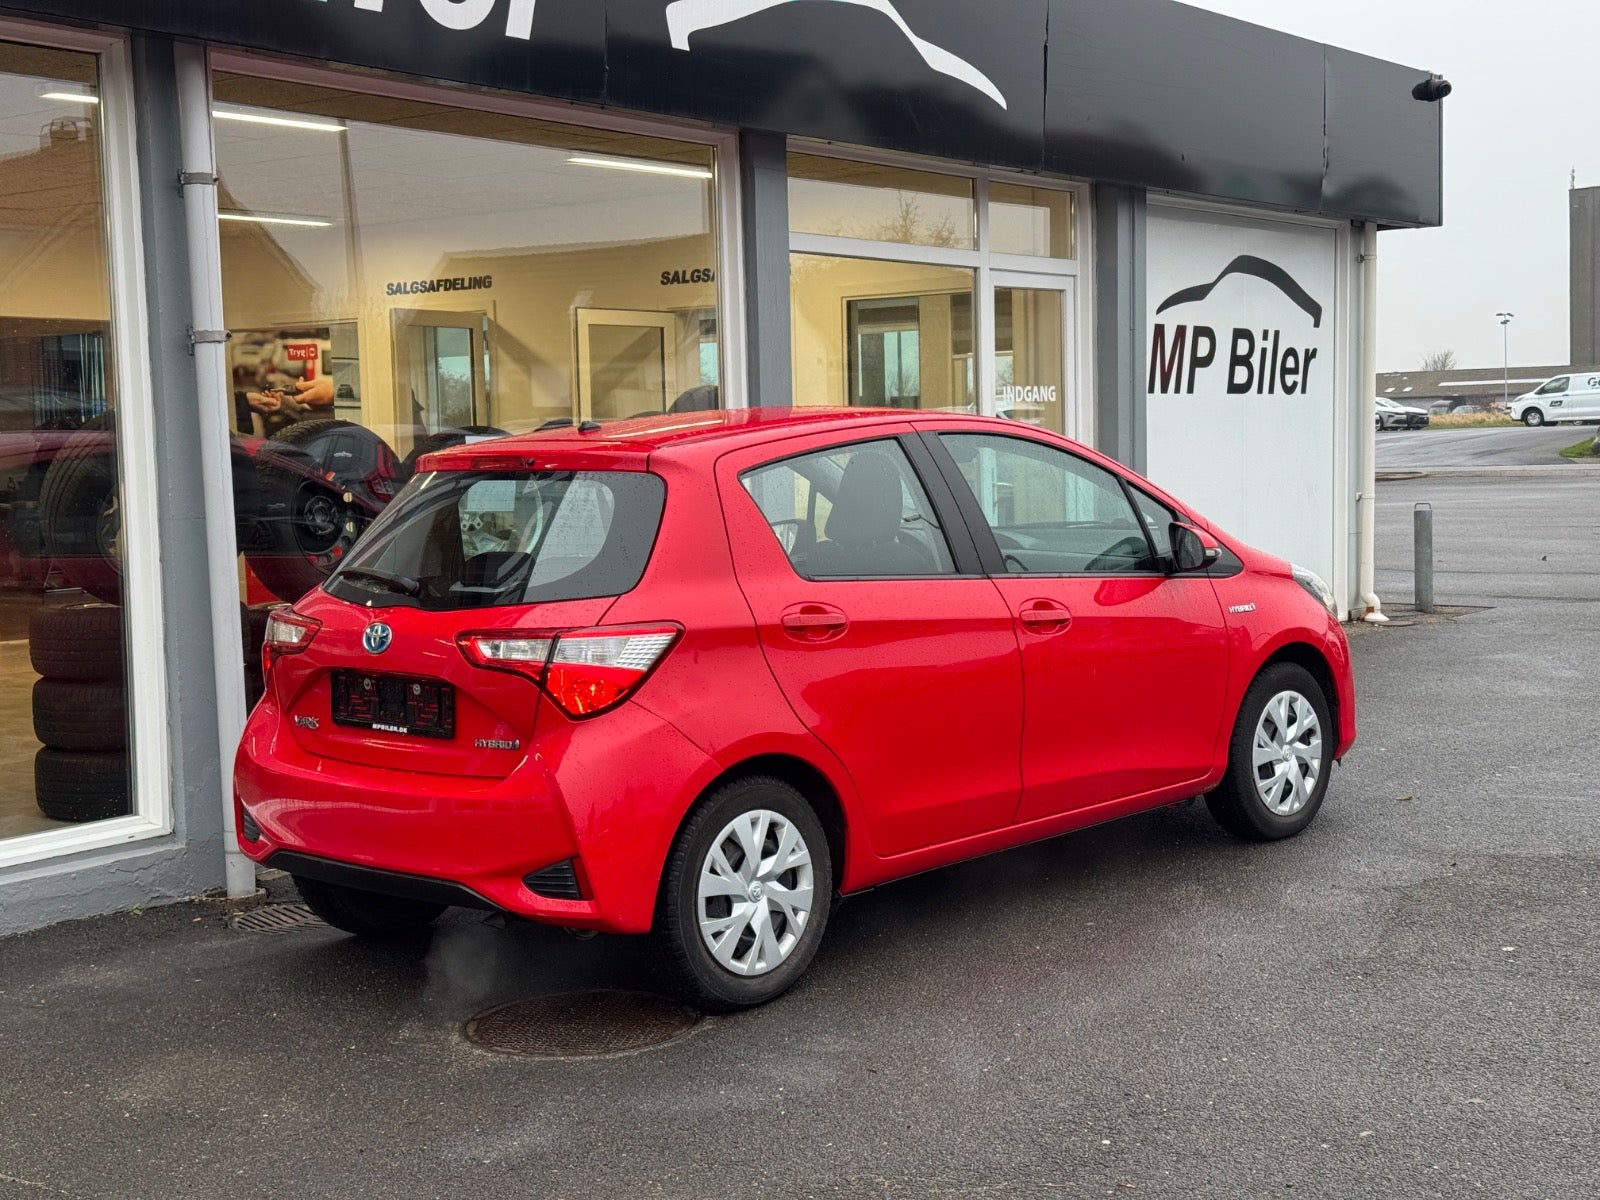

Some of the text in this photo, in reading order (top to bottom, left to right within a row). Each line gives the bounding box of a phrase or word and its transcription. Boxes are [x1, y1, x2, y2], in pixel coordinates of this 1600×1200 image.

[386, 275, 493, 296] SALGSAFDELING
[289, 348, 306, 357] Tryg
[1148, 323, 1318, 396] MP Biler
[1003, 385, 1056, 402] INDGANG
[474, 739, 512, 749] HYBRID
